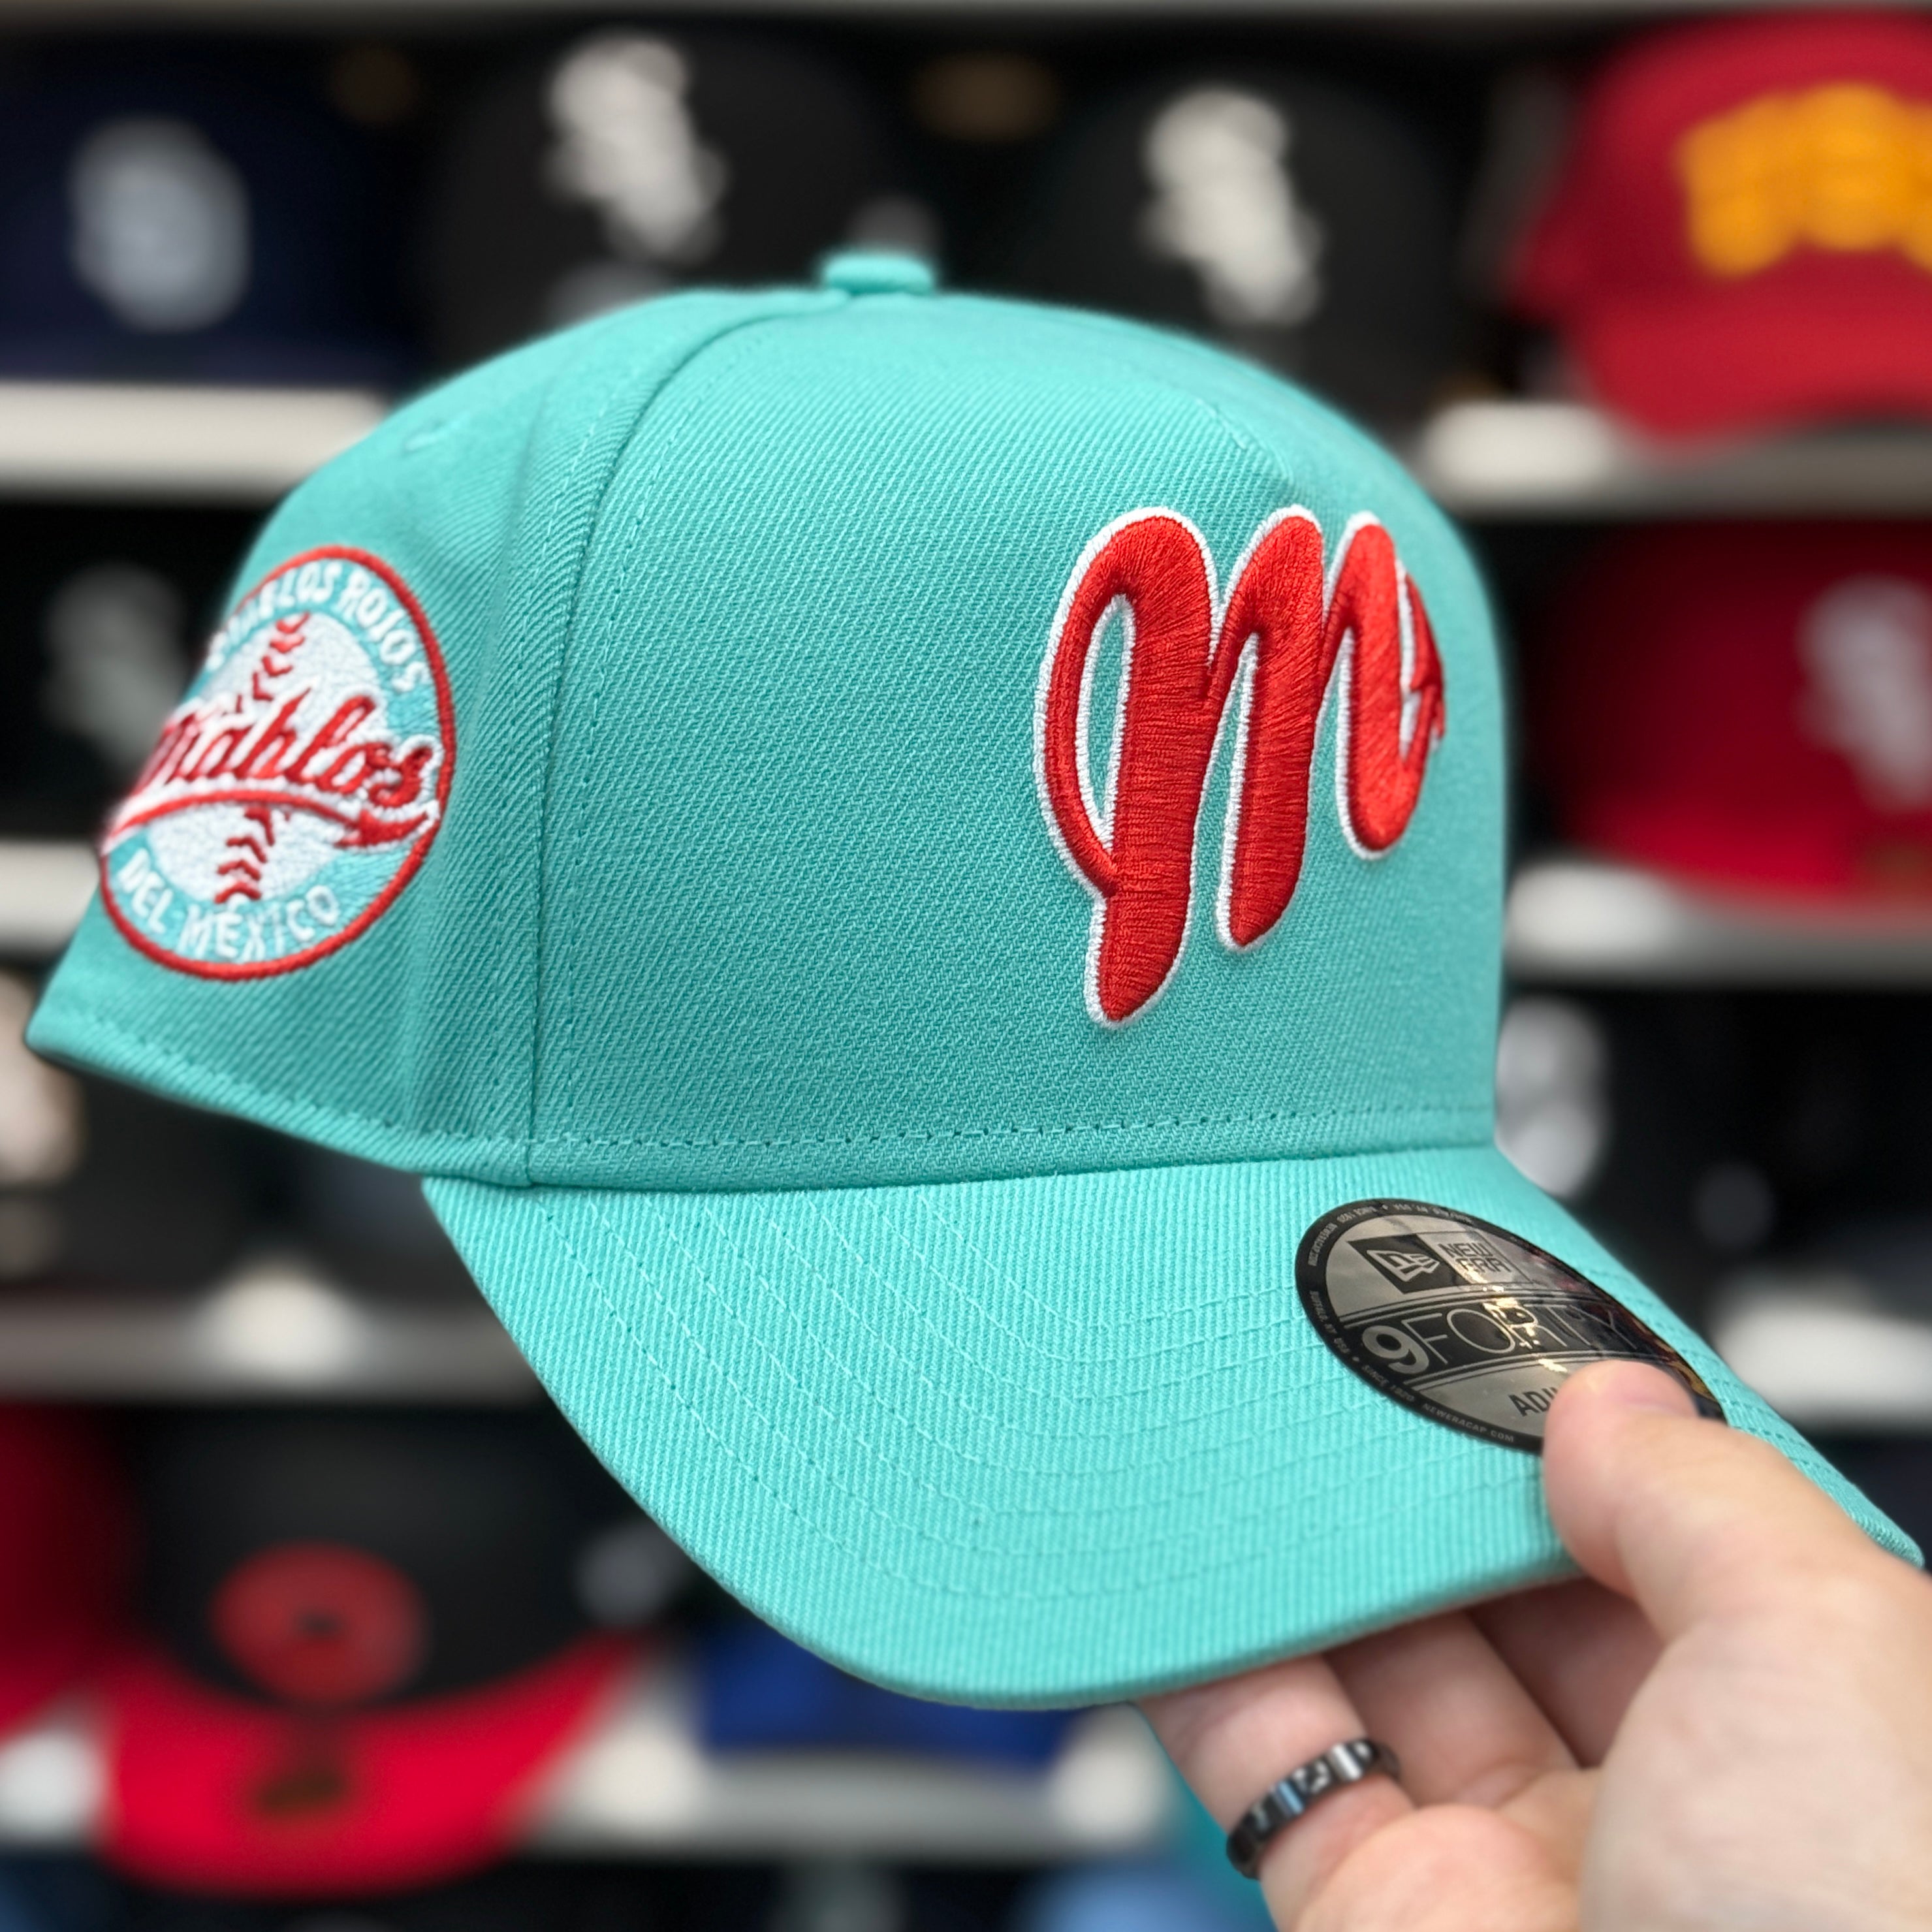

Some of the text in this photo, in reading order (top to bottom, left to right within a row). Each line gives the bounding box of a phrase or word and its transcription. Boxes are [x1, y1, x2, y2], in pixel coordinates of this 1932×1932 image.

[332, 567, 431, 692] ROJOS
[117, 847, 174, 934] DEL
[1438, 1243, 1493, 1258] NEW
[1455, 1258, 1512, 1274] ERA
[1361, 1304, 1638, 1374] 9FORTY
